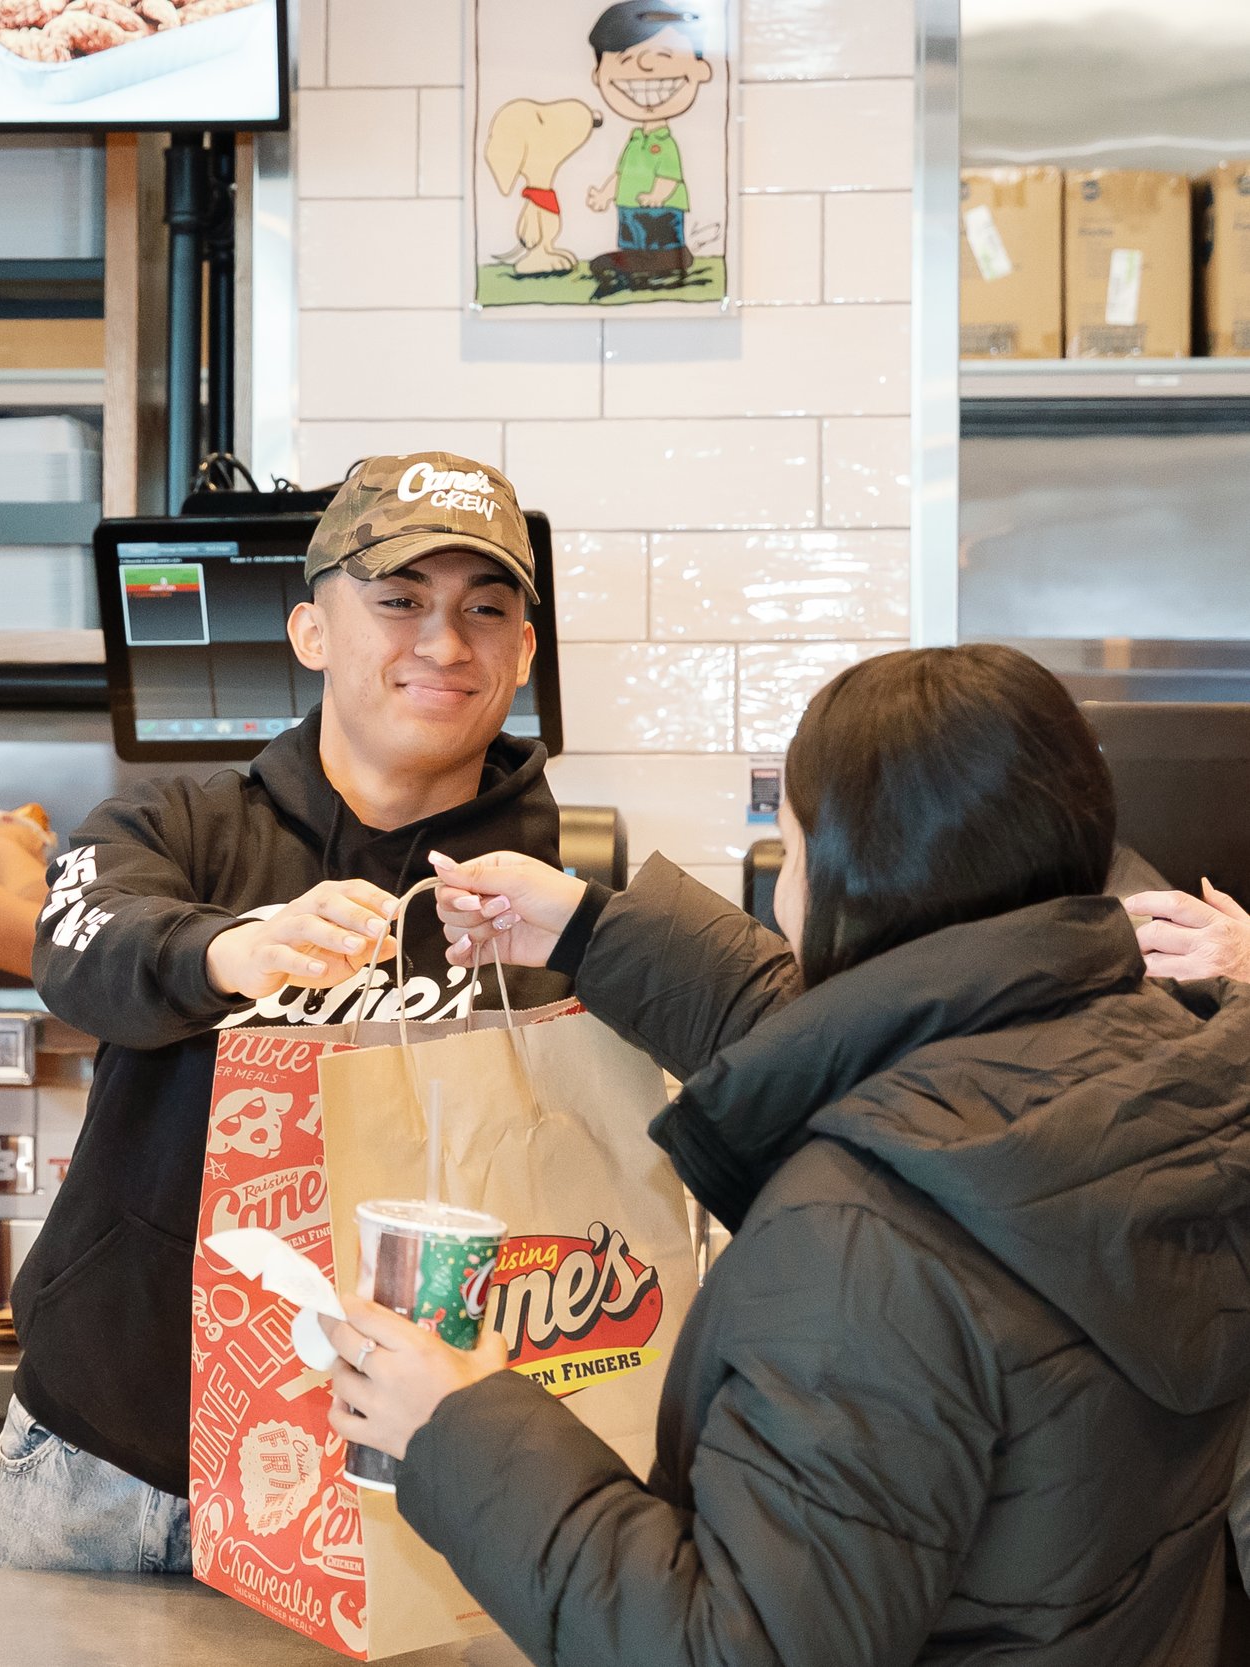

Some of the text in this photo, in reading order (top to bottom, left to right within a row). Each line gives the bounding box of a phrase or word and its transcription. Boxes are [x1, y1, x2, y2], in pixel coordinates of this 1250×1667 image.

[398, 462, 494, 502] Cane's
[430, 490, 501, 521] CREW
[242, 1170, 299, 1201] Raising
[494, 1242, 559, 1273] ising
[561, 1351, 642, 1382] FINGERS
[217, 1536, 326, 1628] Craveable
